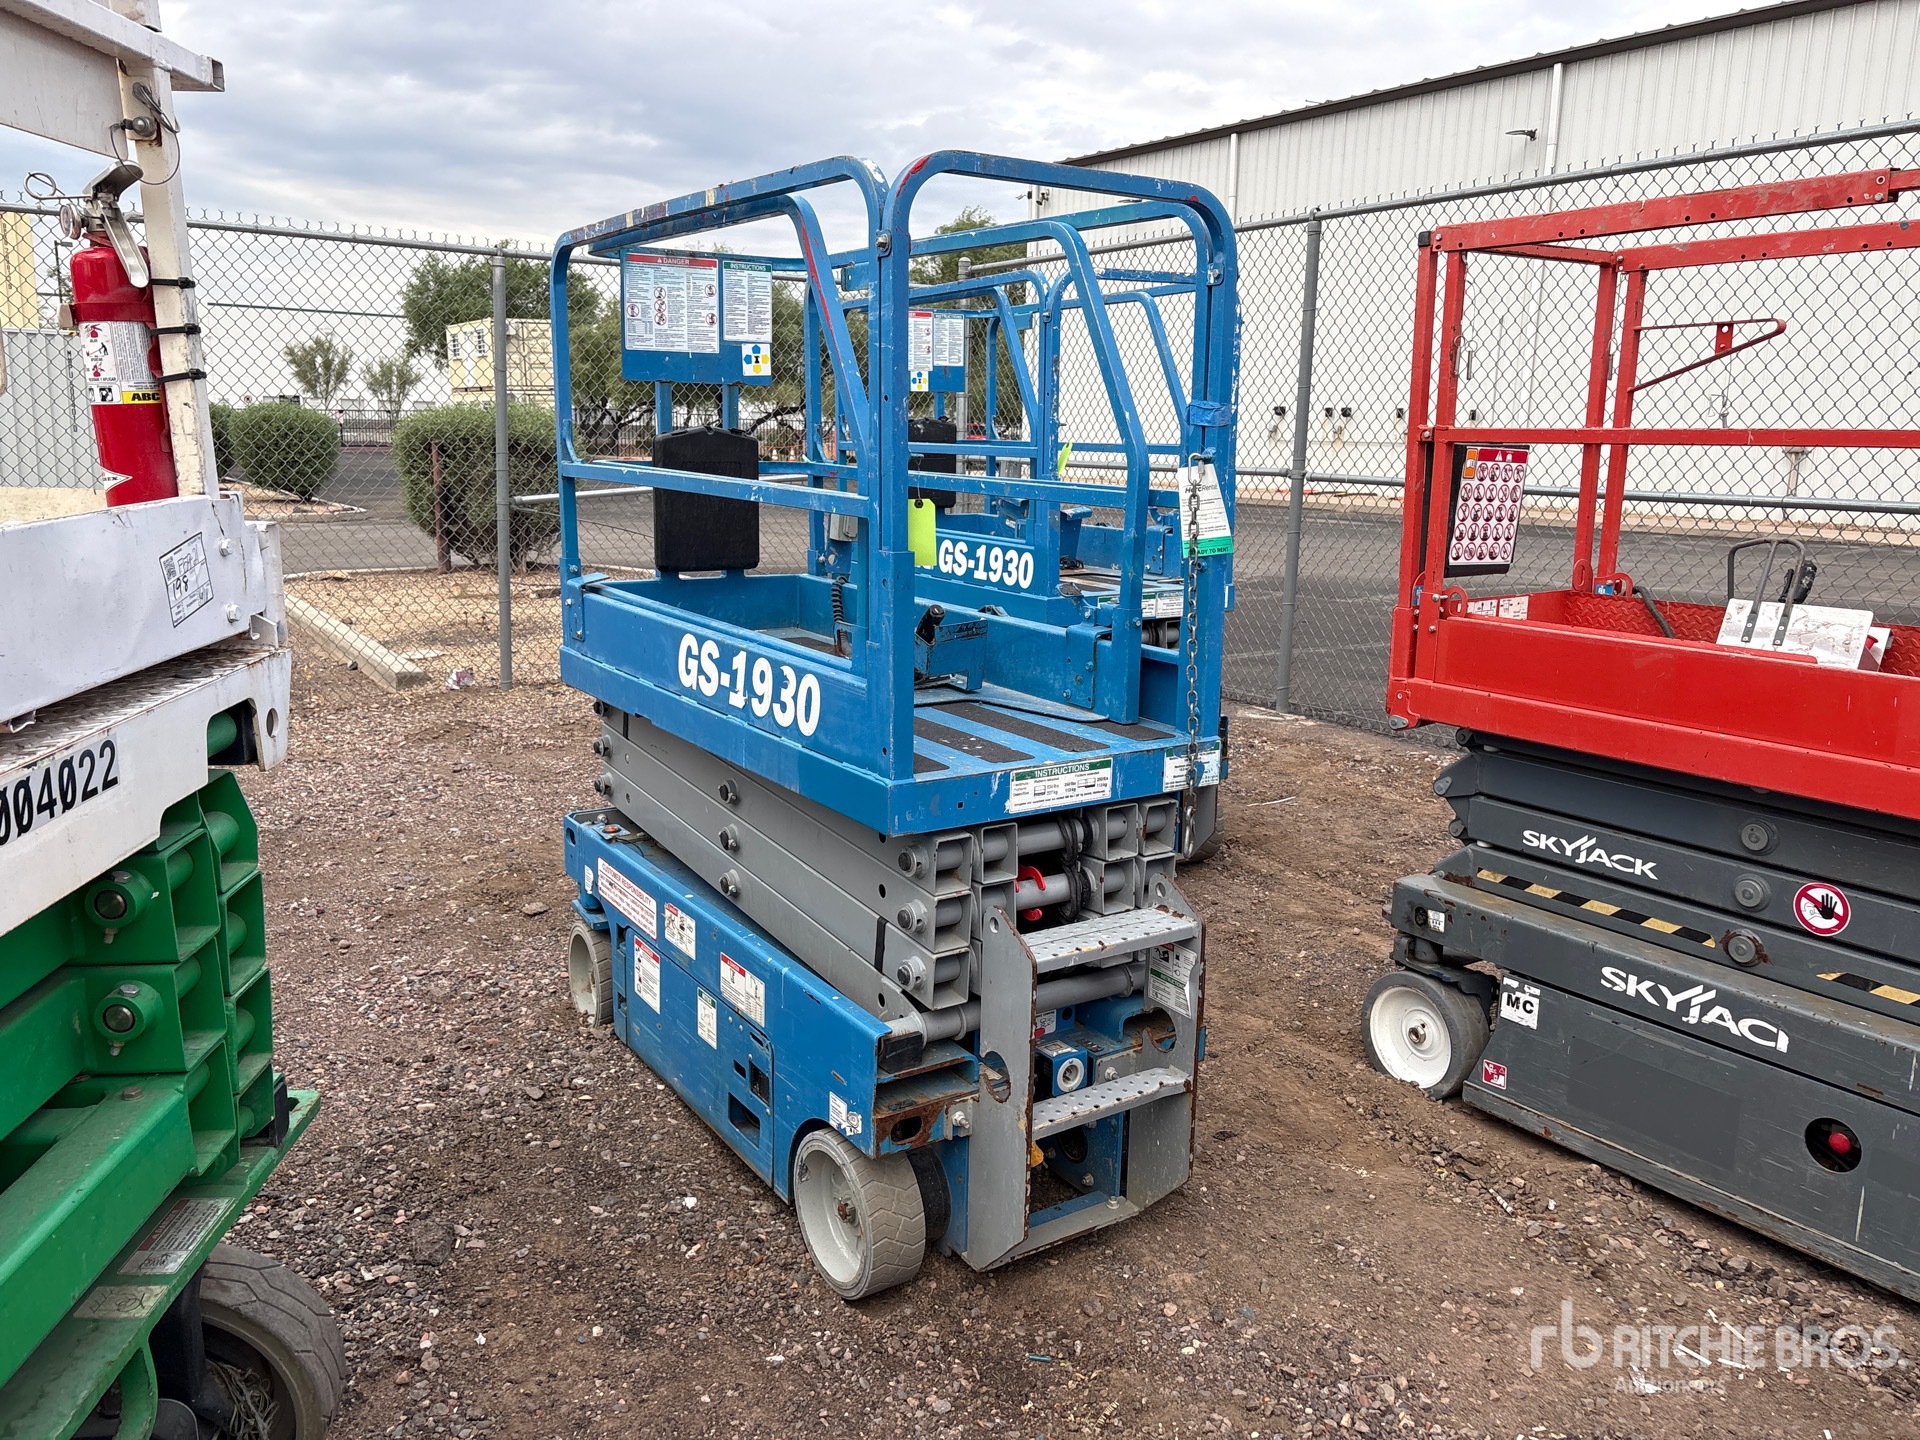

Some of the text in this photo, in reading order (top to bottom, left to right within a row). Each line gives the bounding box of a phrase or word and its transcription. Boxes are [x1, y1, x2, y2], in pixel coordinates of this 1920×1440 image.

[730, 263, 766, 271] INSTRUCTIONS
[131, 392, 161, 402] ABC
[939, 539, 1034, 589] GS-1930
[678, 633, 821, 737] GS-1930
[1034, 763, 1090, 778] INSTRUCTIONS
[1522, 829, 1658, 880] SKYJACK
